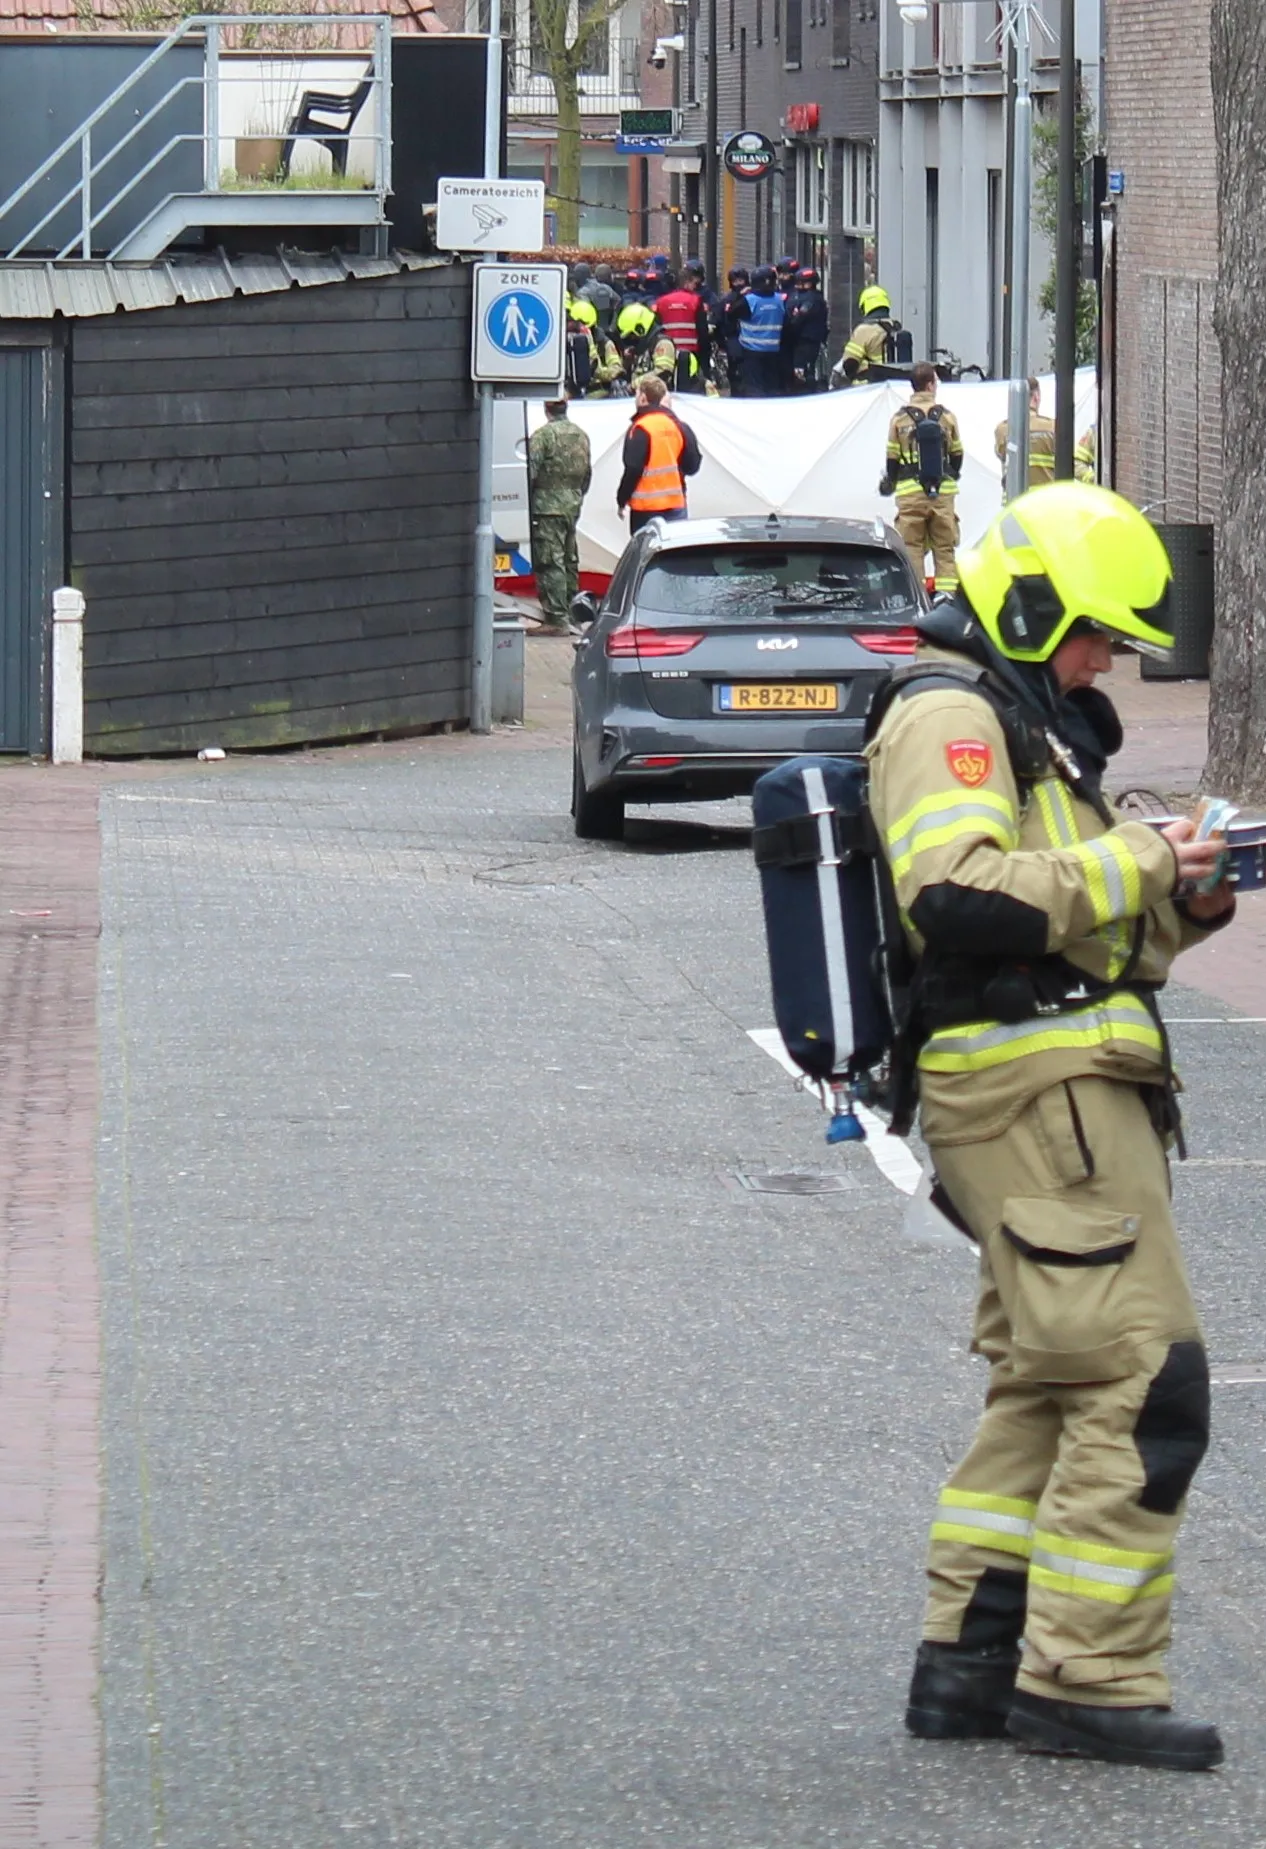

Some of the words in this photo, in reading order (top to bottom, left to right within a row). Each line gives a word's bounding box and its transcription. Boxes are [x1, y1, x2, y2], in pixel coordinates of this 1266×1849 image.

[731, 154, 770, 164] MILANO
[443, 185, 540, 198] Cameratoezicht
[500, 273, 540, 285] ZONE
[493, 493, 520, 501] FENSIE
[756, 638, 799, 650] KIA
[738, 688, 828, 706] R-822-NJ
